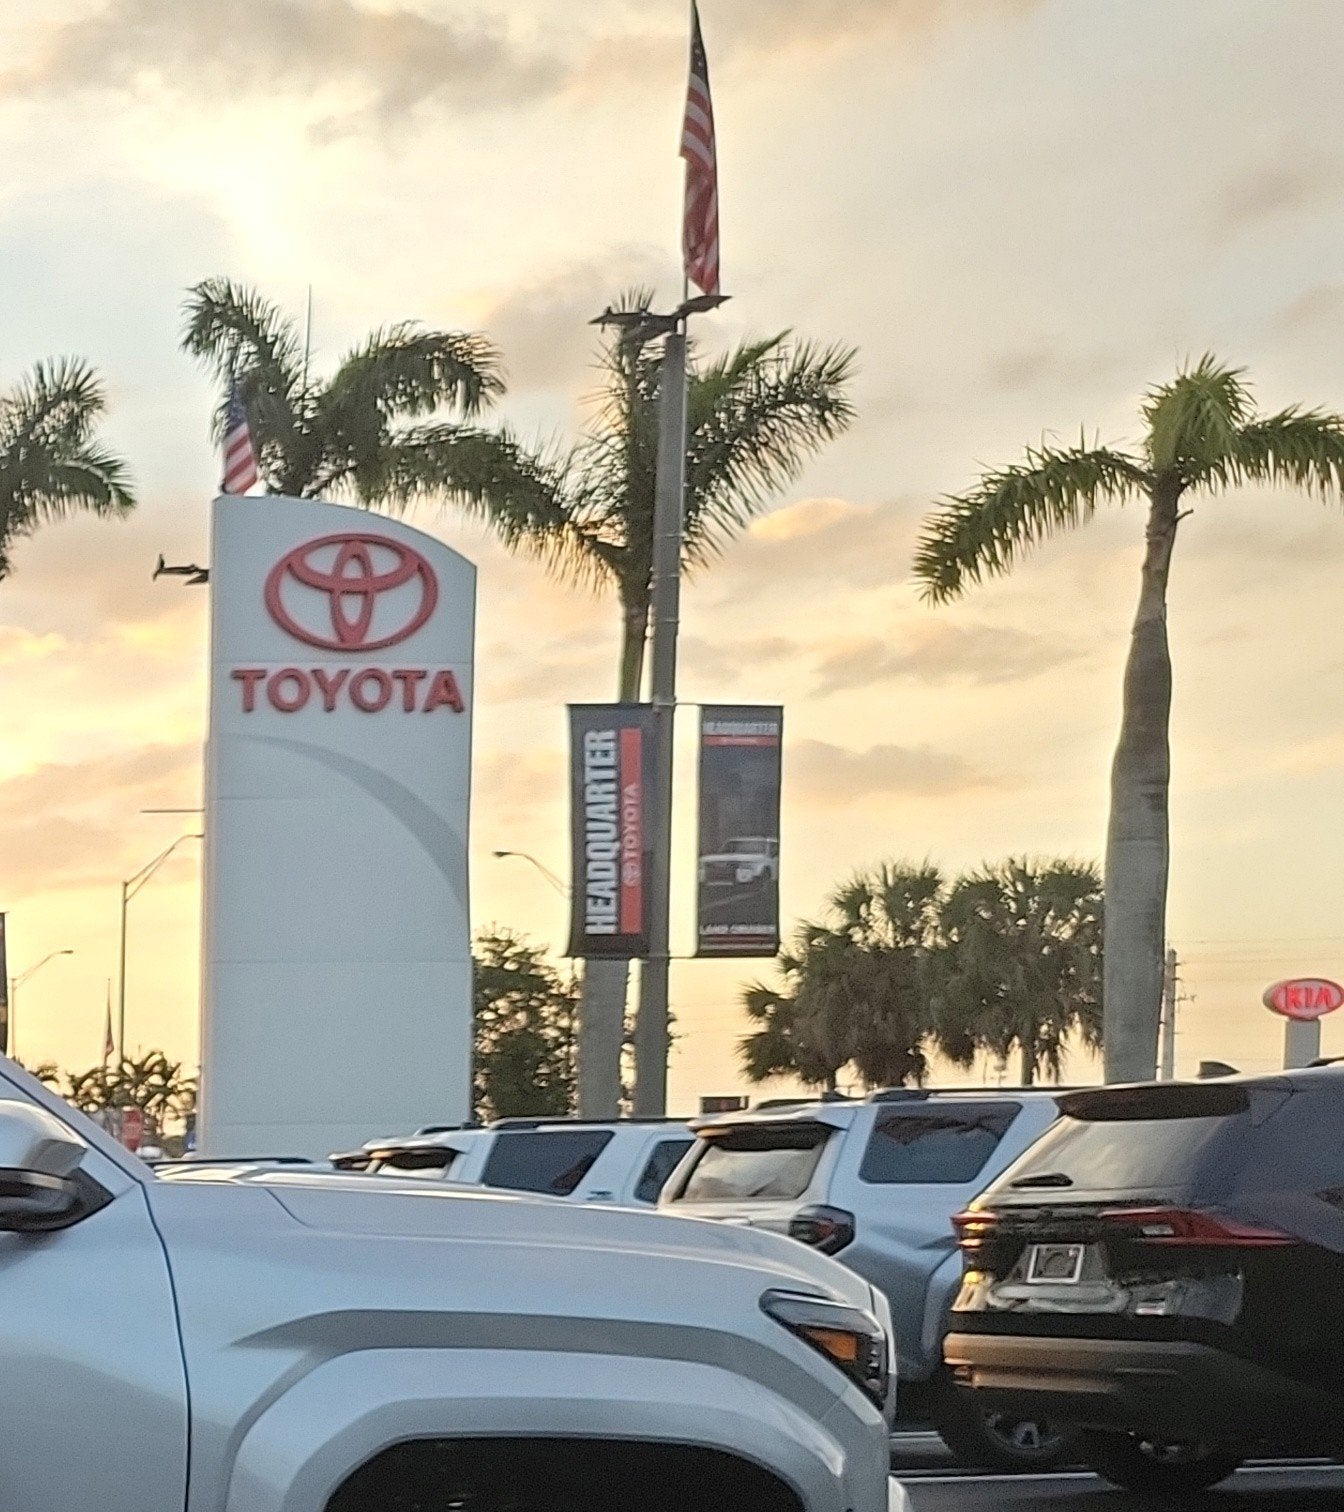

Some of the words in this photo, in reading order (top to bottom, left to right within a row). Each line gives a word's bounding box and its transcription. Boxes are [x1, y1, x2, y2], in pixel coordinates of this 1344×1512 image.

[230, 668, 465, 713] TOYOTA
[584, 730, 619, 935] HEADQUARTER
[623, 783, 642, 861] TOYOTA
[1285, 986, 1333, 1009] KIA
